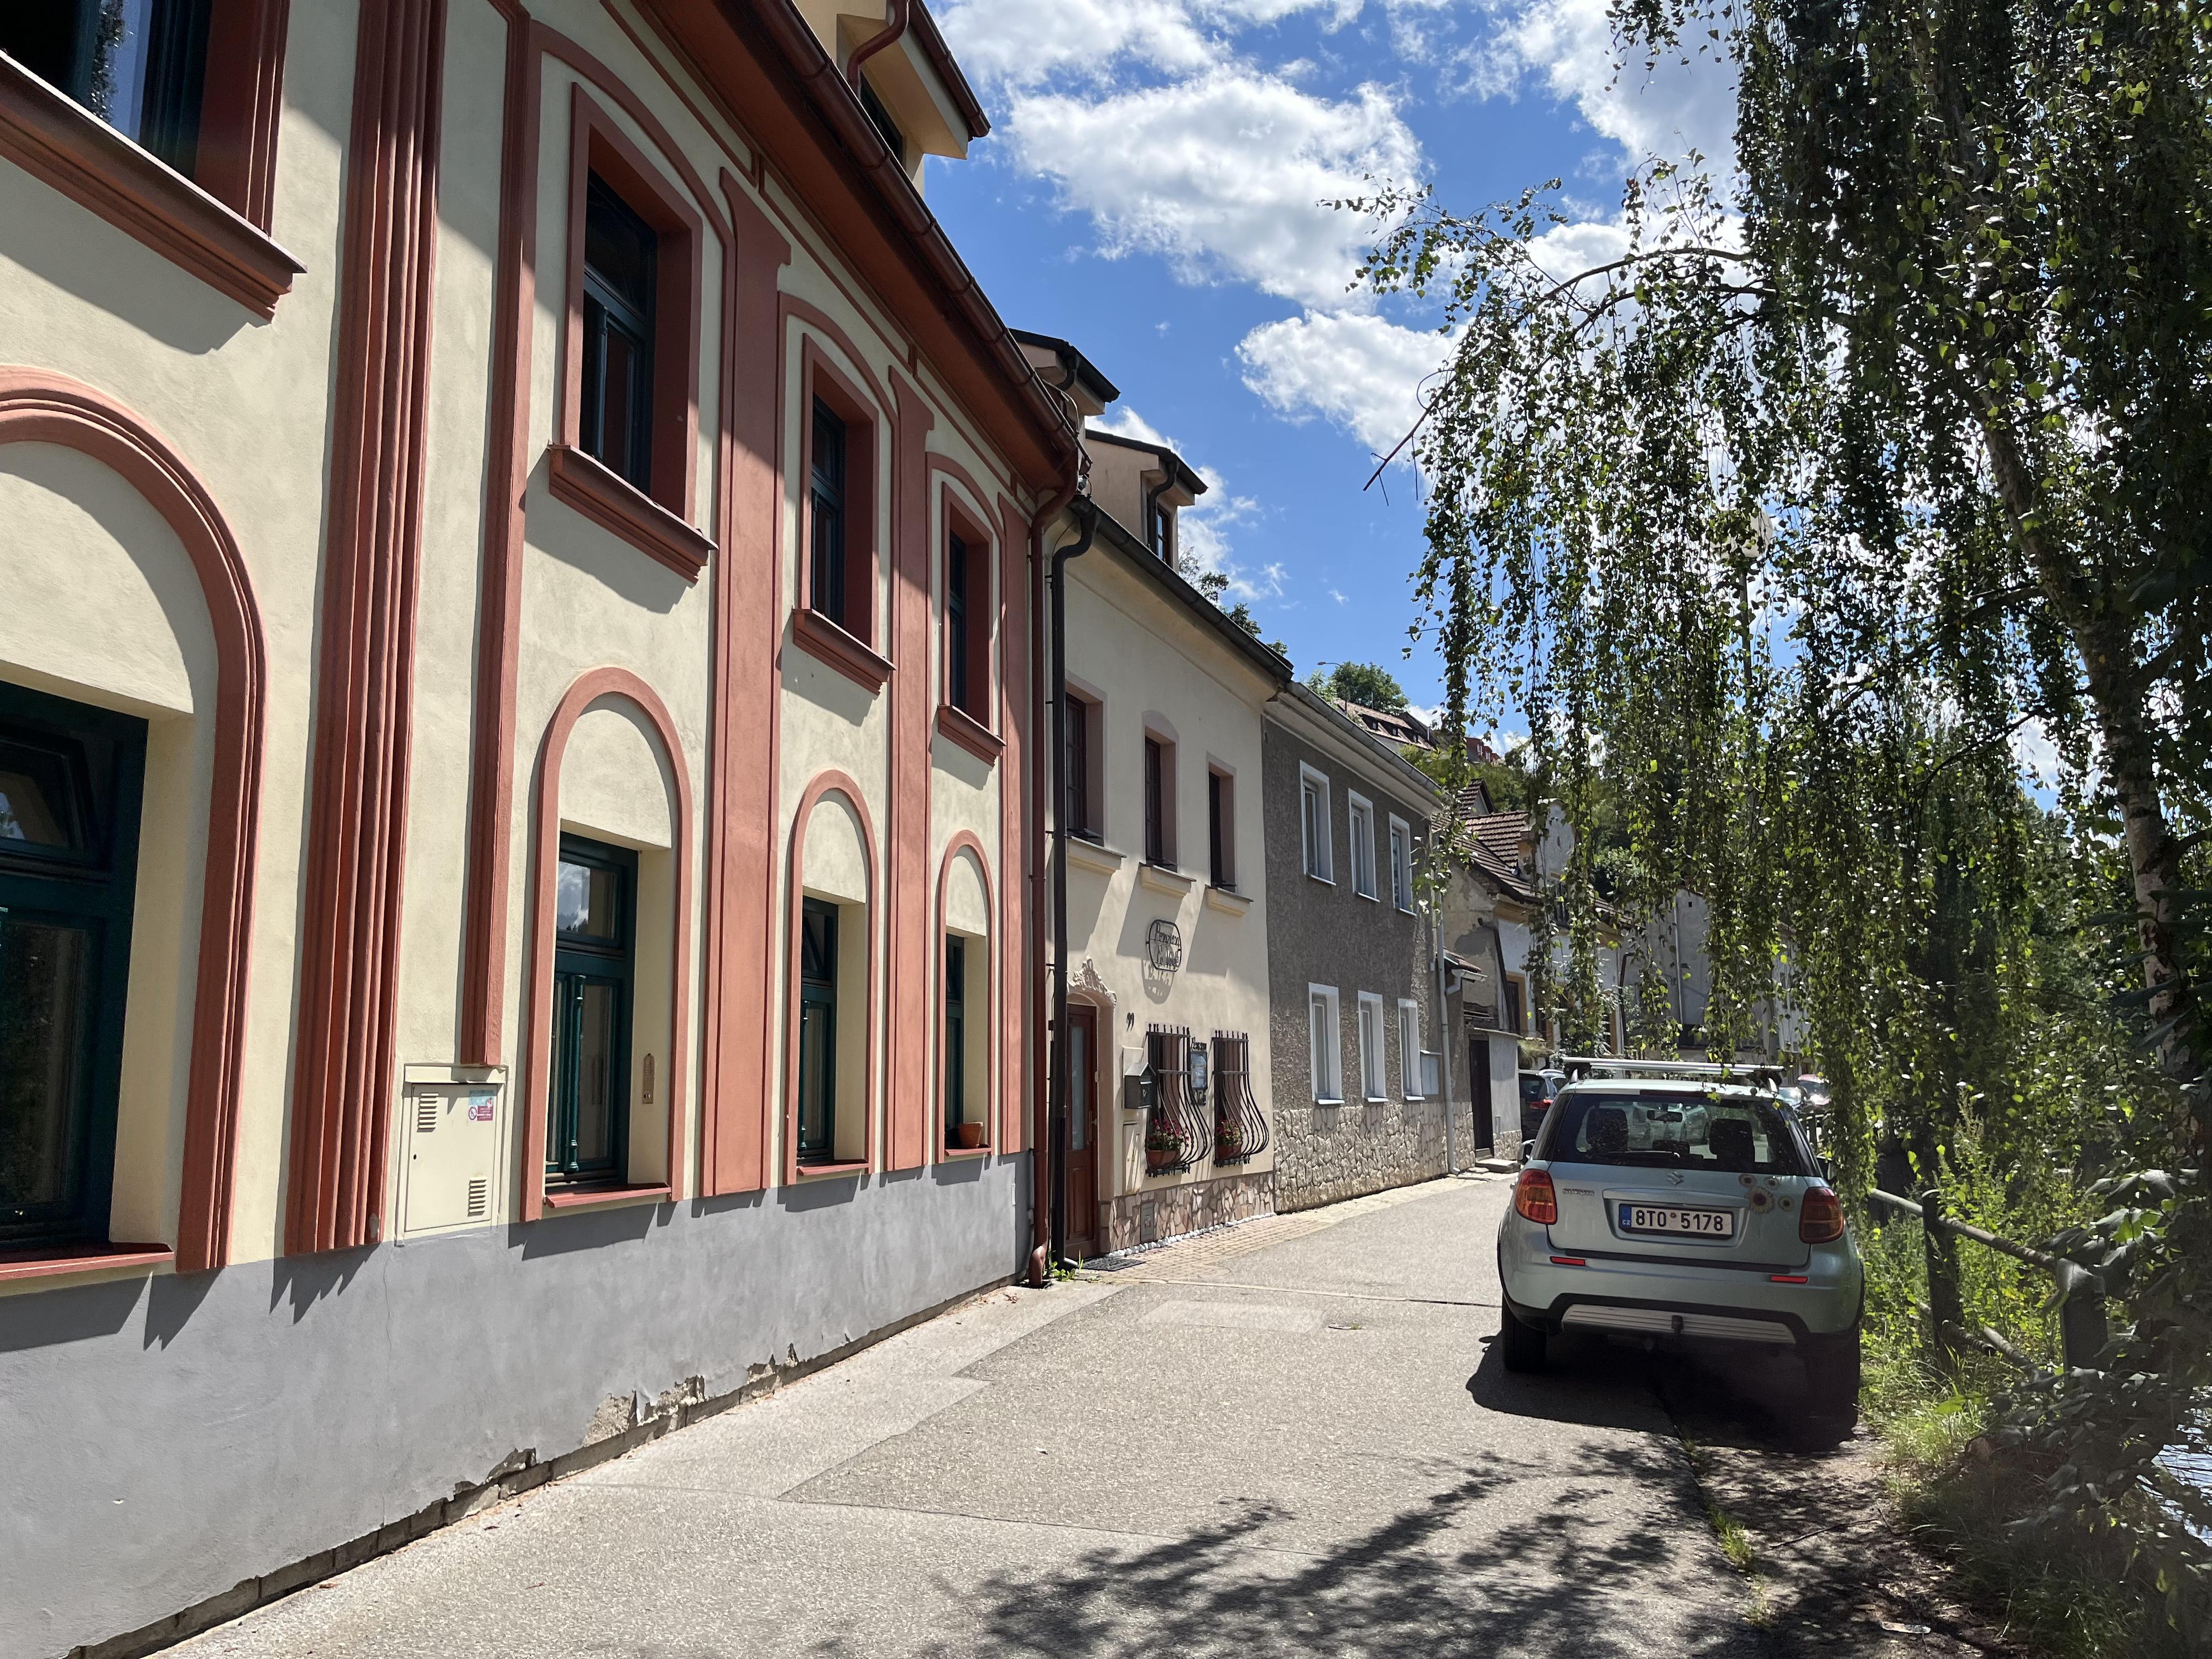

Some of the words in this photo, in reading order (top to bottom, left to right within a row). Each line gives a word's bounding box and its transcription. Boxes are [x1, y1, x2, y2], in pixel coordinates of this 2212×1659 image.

[1126, 1012, 1134, 1031] 99
[1635, 1209, 1667, 1228] 8T0
[1681, 1213, 1723, 1232] 5178
